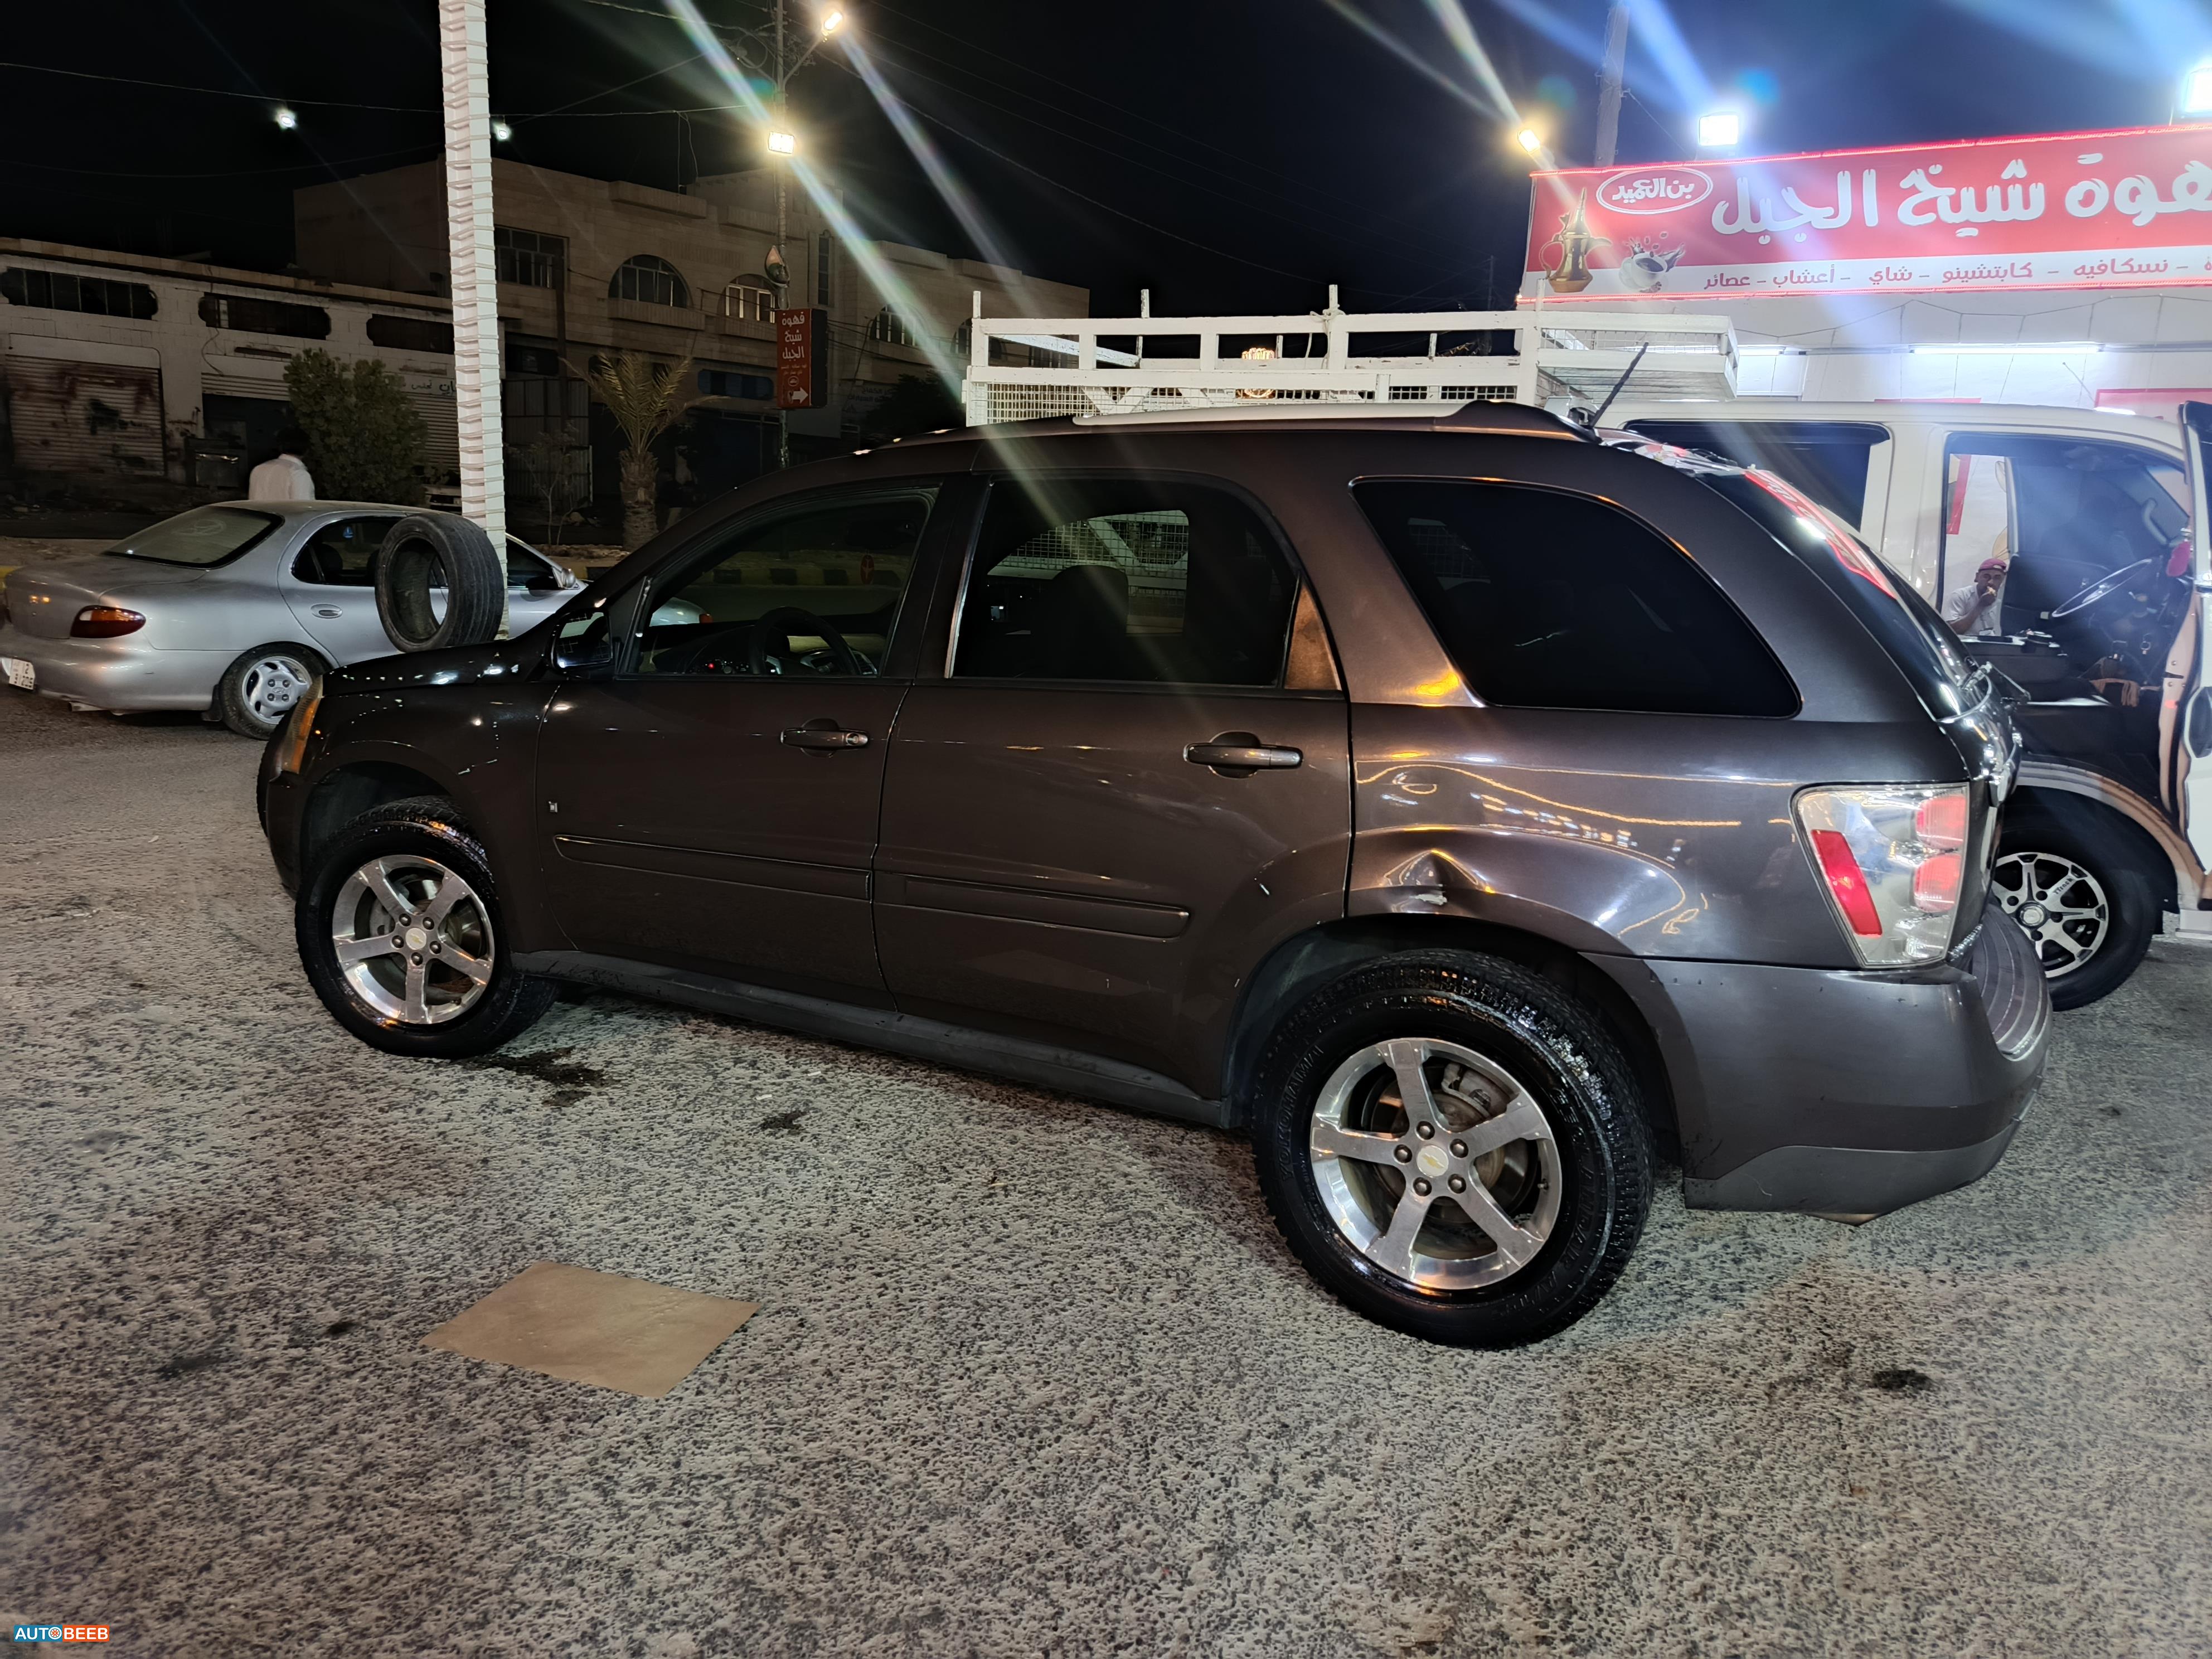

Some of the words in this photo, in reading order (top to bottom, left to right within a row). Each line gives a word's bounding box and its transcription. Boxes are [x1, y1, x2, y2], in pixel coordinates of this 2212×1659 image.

[1612, 177, 1666, 203] العميد
[1666, 180, 1695, 200] بن
[1898, 158, 2045, 237] شيخ
[2065, 153, 2212, 226] هوة
[1711, 168, 1879, 245] الجبل
[1773, 264, 1835, 288] أعشاب
[1868, 265, 1913, 285] شاي
[1942, 261, 2033, 283] كابتشينو
[2073, 257, 2169, 279] نسكافيه
[1704, 273, 1750, 290] عصائر
[782, 311, 805, 327] قهوة
[784, 329, 803, 345] شيخ
[782, 346, 805, 362] الجبل
